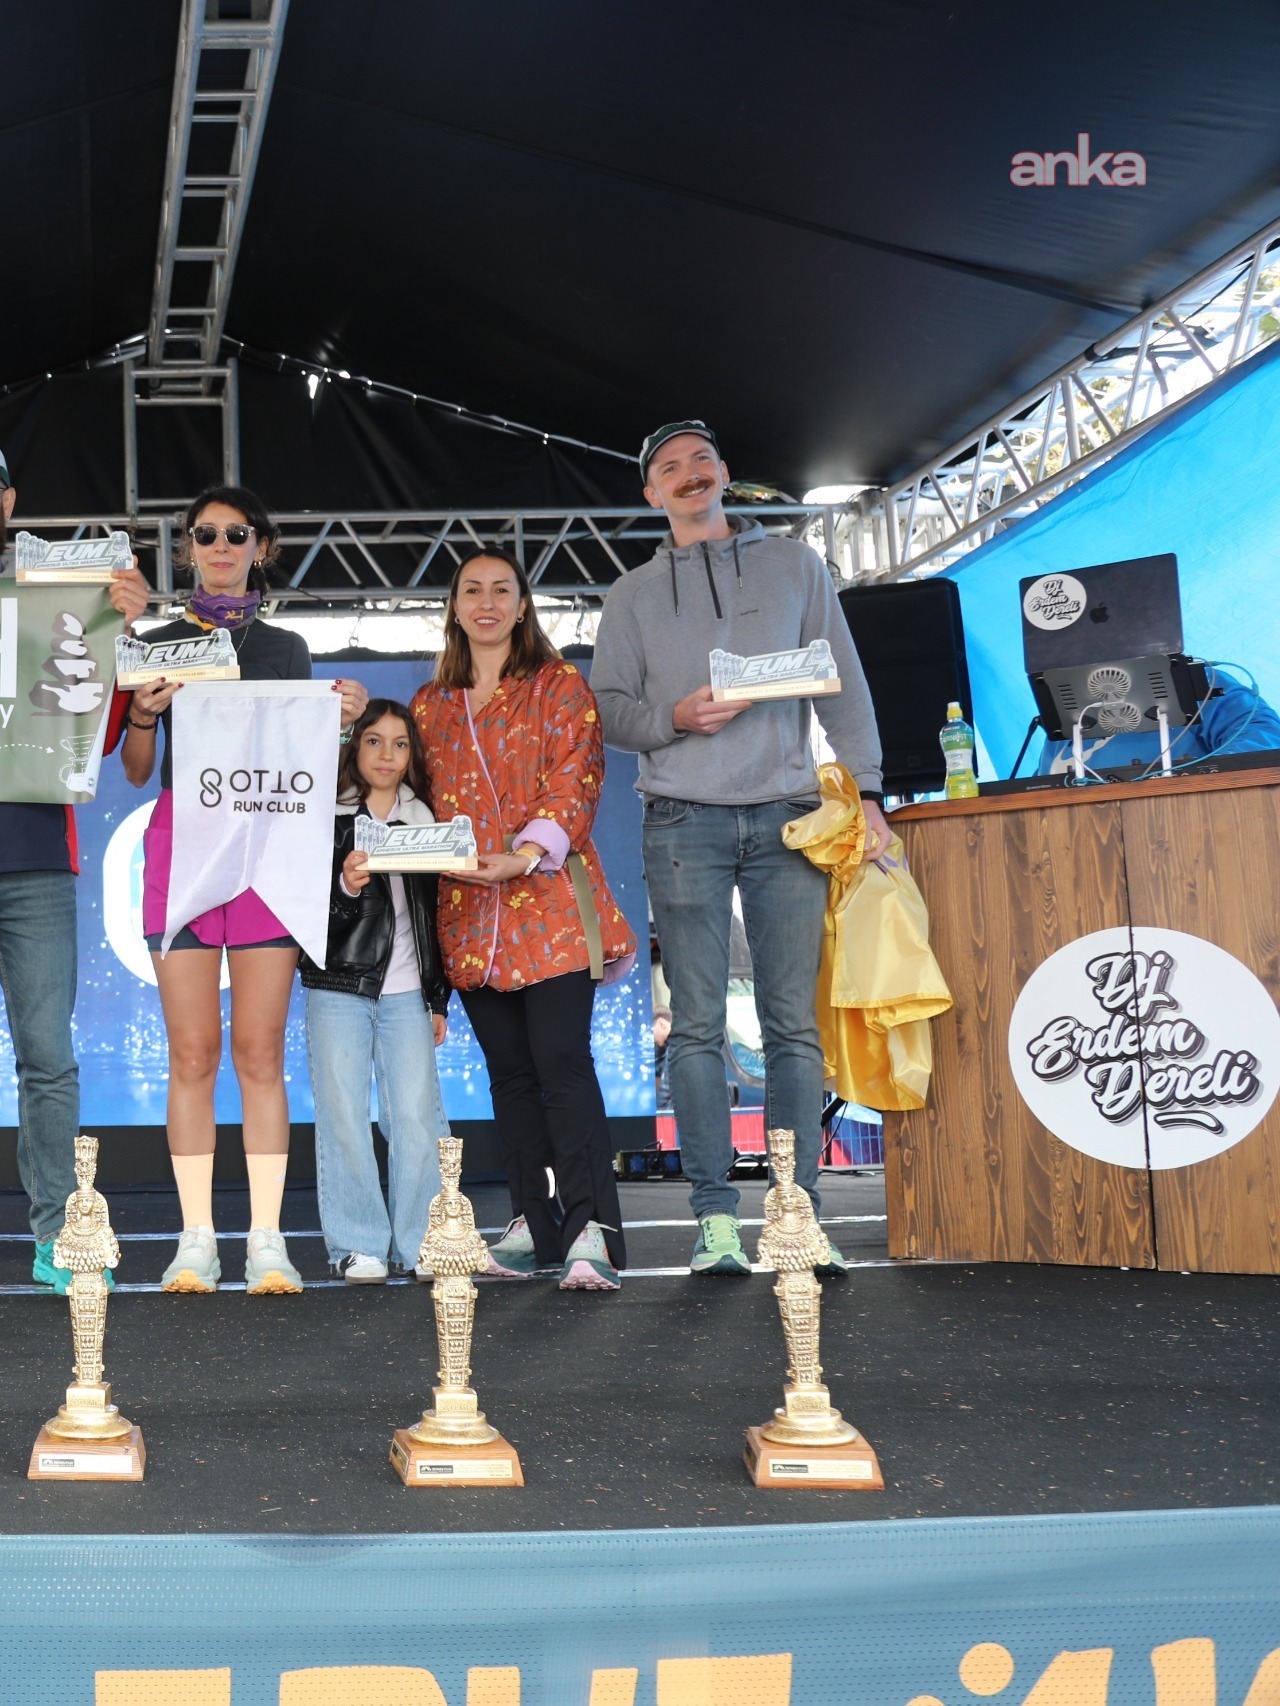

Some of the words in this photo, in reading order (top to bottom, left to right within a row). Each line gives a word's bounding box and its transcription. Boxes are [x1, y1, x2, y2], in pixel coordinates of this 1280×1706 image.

[44, 542, 109, 562] EUM
[1043, 579, 1063, 597] Dj
[1028, 594, 1069, 612] Erdem
[1041, 600, 1080, 620] Dereli
[148, 640, 211, 665] EUM
[741, 651, 809, 678] EUM
[229, 769, 314, 795] OTTO
[233, 801, 263, 813] RUN
[266, 801, 306, 814] CLUB
[384, 826, 451, 847] EUM
[1085, 950, 1180, 1024] Dj
[1026, 1014, 1206, 1082] Erdem
[1084, 1049, 1262, 1124] Dereli
